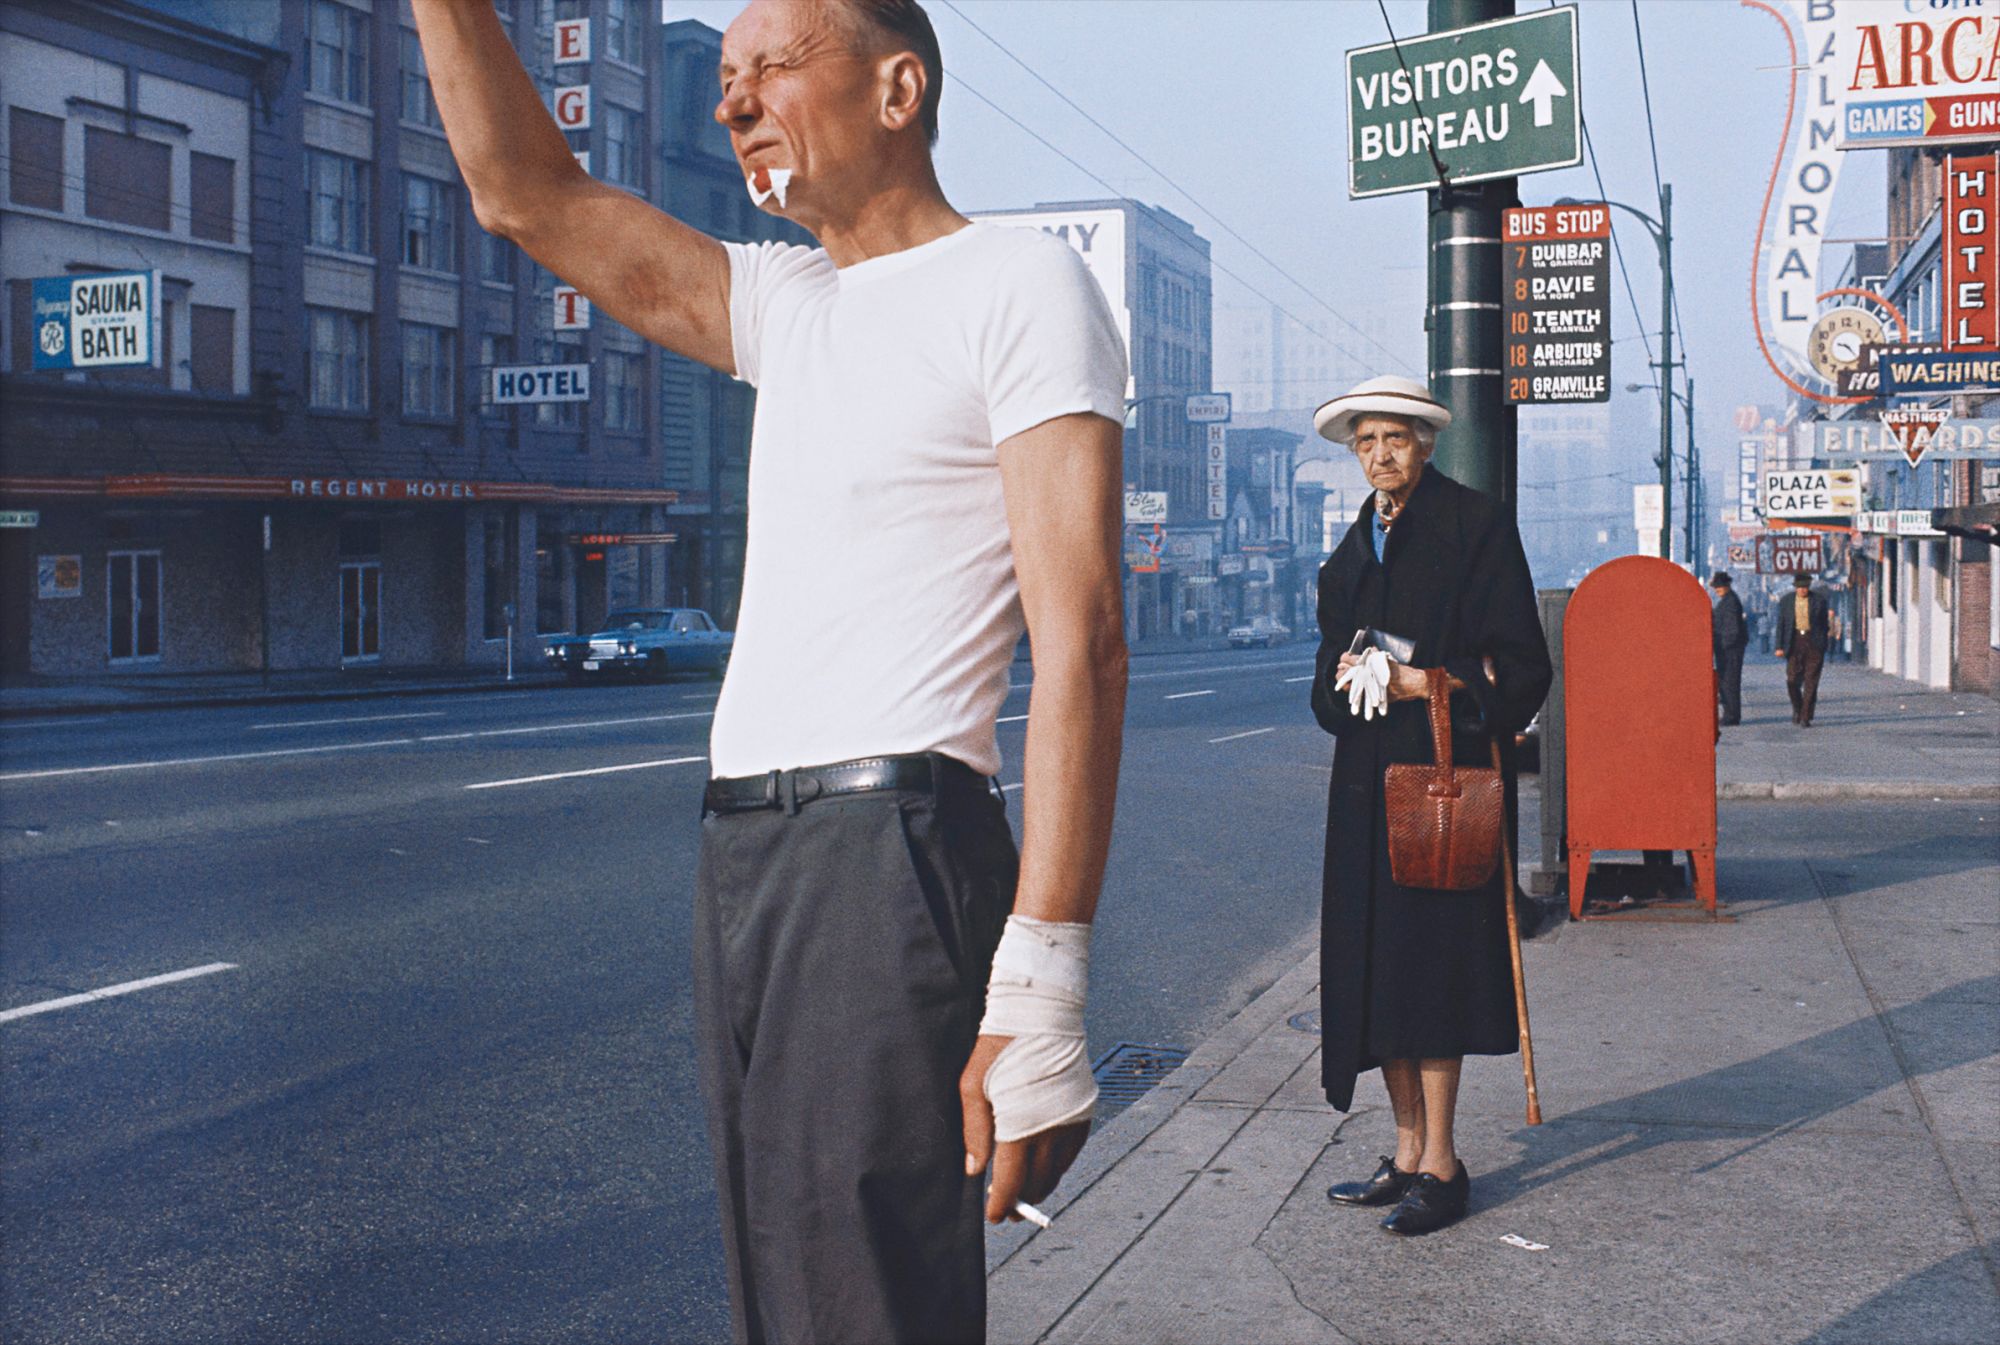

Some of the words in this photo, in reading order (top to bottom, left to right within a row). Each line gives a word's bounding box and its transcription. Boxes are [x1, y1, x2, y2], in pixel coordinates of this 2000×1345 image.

[1356, 48, 1519, 110] VISITORS
[1848, 104, 1922, 133] GAMES
[1949, 100, 2000, 128] GUN
[1361, 103, 1509, 162] BUREAU
[1509, 213, 1546, 236] BUS
[1556, 210, 1604, 234] STOP
[1515, 246, 1527, 269] 7
[1532, 243, 1603, 262] DUNBAR
[1532, 260, 1546, 268] VIA
[1550, 258, 1594, 267] GRANVILLE
[1958, 170, 1986, 345] HOTEL
[76, 282, 142, 316] SAUNA
[1515, 278, 1528, 301] 8
[1532, 276, 1595, 294] DAVIE
[1511, 312, 1529, 334] 10
[1532, 309, 1601, 327] TENTH
[1533, 326, 1546, 334] VIA
[1550, 325, 1594, 333] GRANVILLE
[81, 326, 137, 359] BATH
[1510, 345, 1527, 367] 18
[1533, 343, 1602, 360] ARBUTUS
[1533, 359, 1547, 367] VIA
[499, 370, 585, 398] HOTEL
[1510, 377, 1529, 400] 20
[1533, 376, 1605, 393] GRANVILLE
[1534, 392, 1547, 400] VIA
[1550, 391, 1595, 400] GRANVILLE
[1886, 412, 1946, 423] HASTINGS
[1211, 426, 1221, 517] HOTEL
[1769, 475, 1827, 491] PLAZA
[291, 480, 388, 496] REGENT
[406, 483, 475, 498] HOTEL
[1127, 493, 1156, 507] Blue
[1769, 494, 1828, 511] CAFE
[1776, 538, 1818, 548] WESTERN
[1776, 552, 1817, 570] GYM
